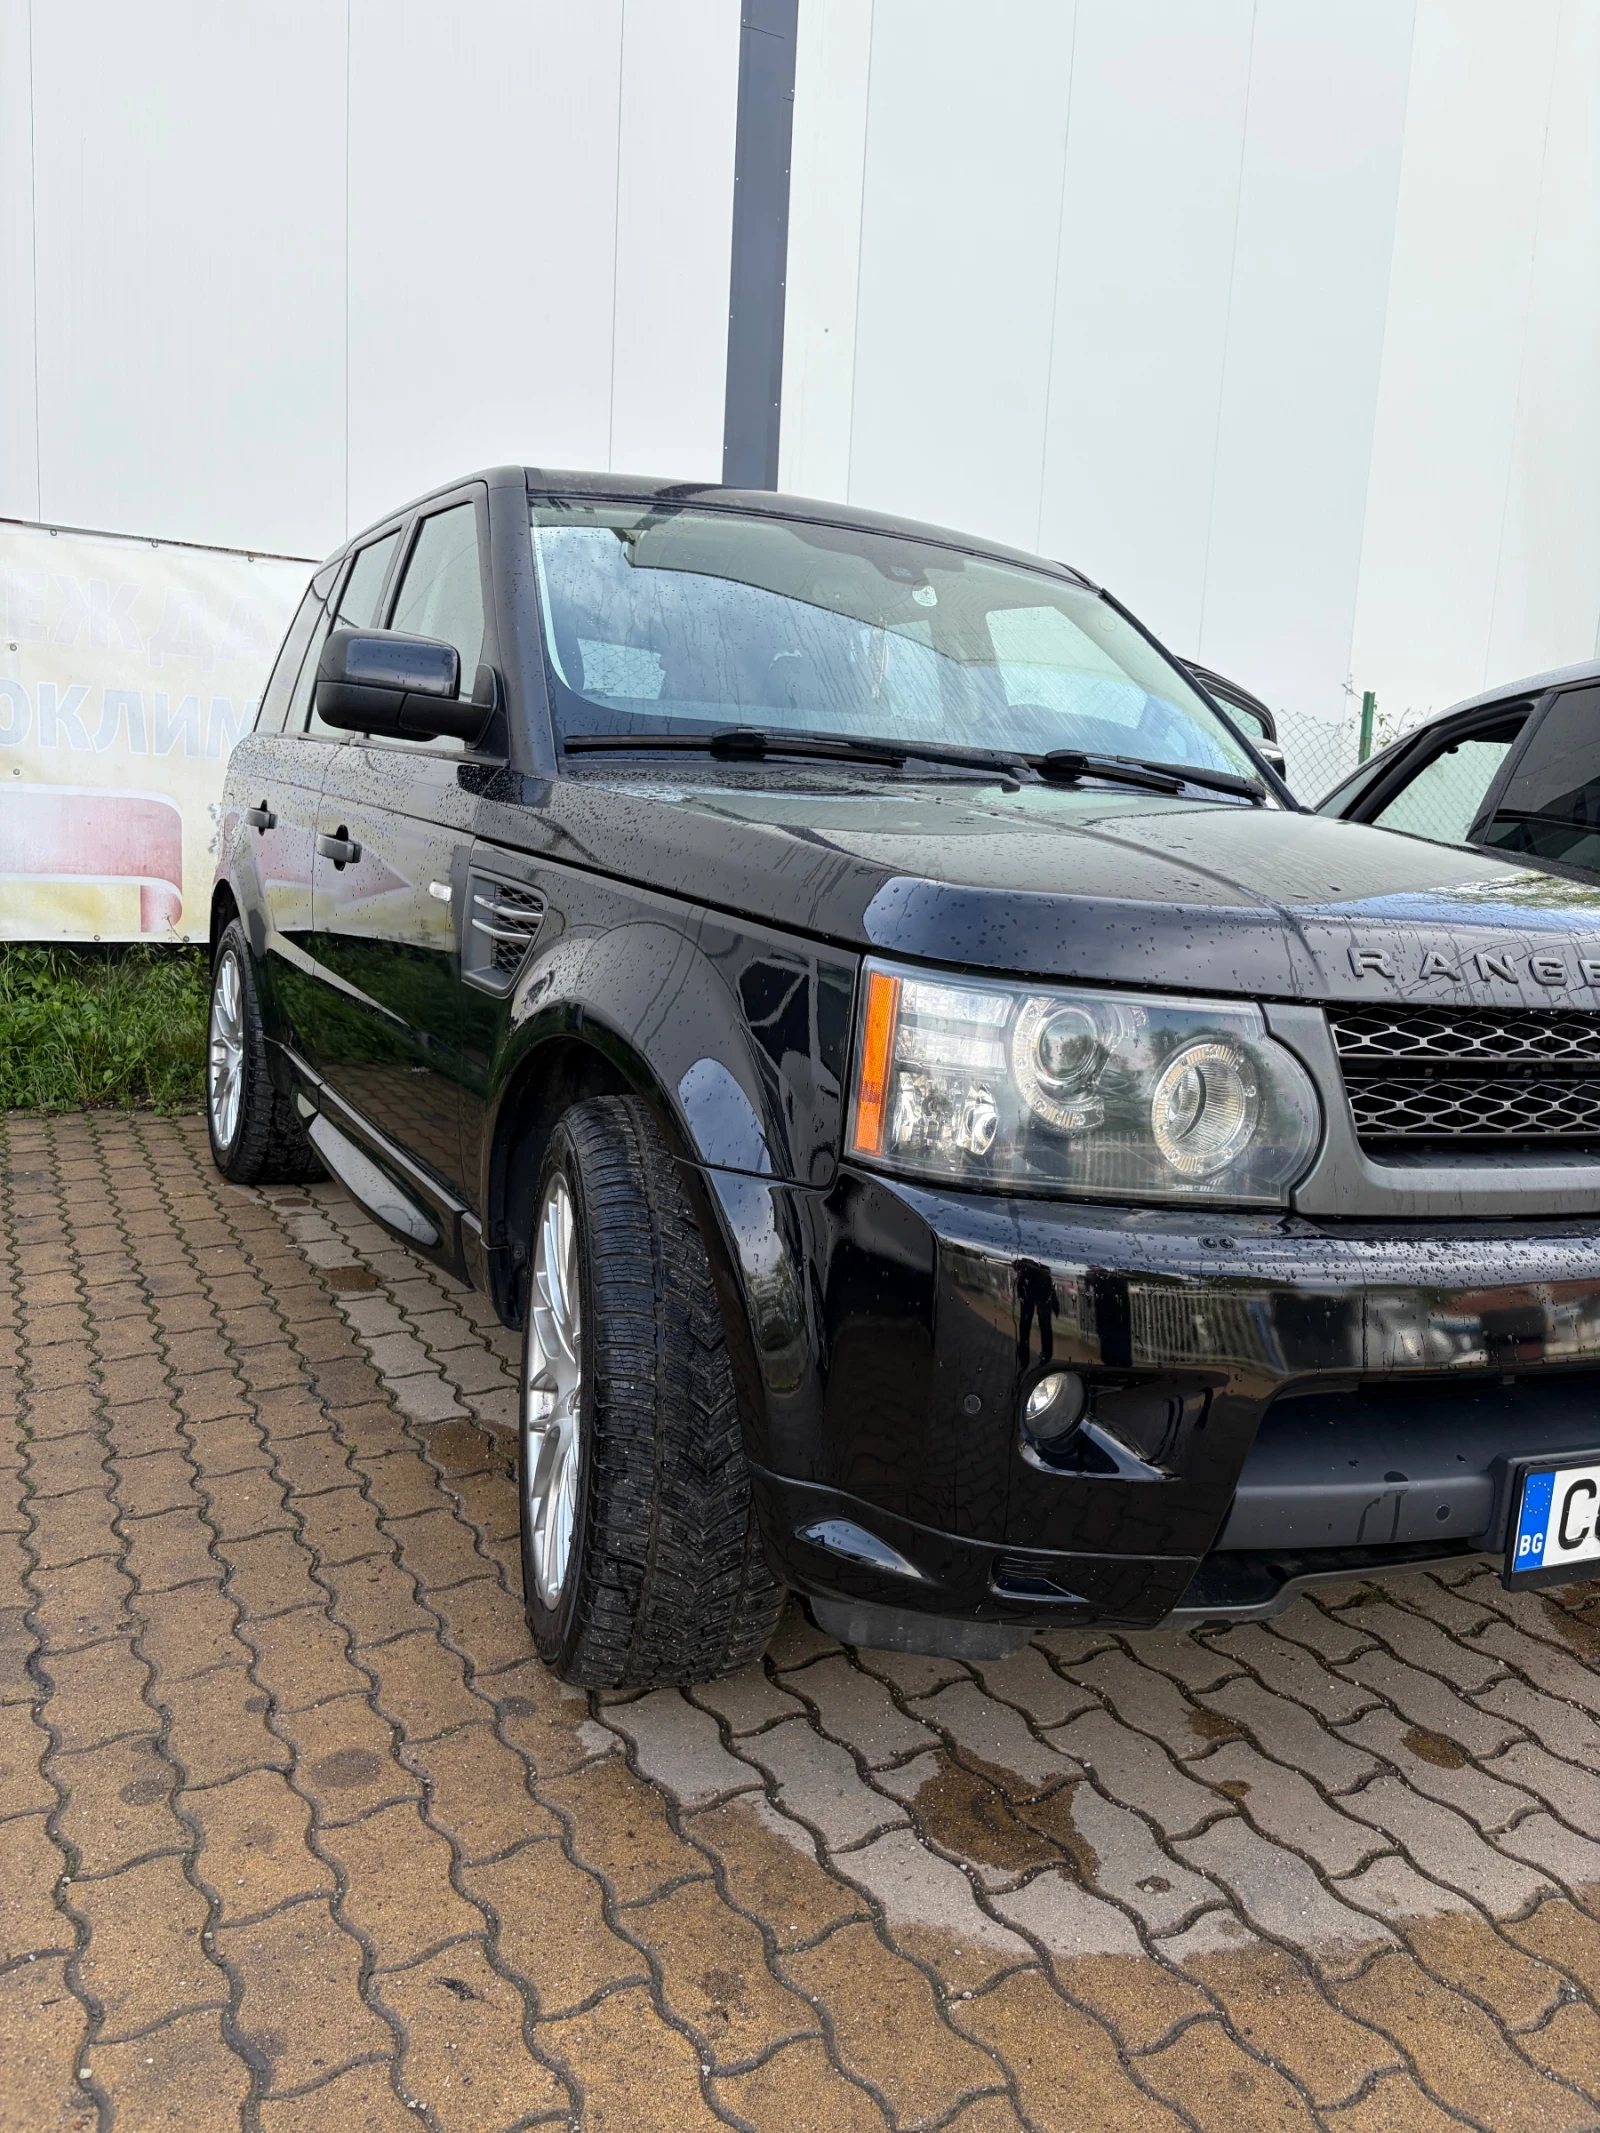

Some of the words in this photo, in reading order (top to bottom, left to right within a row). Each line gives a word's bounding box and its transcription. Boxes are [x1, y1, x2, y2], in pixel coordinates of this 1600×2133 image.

[6, 571, 290, 672] ЕЖДА
[1519, 1533, 1543, 1556] BG
[1558, 1478, 1600, 1550] C
